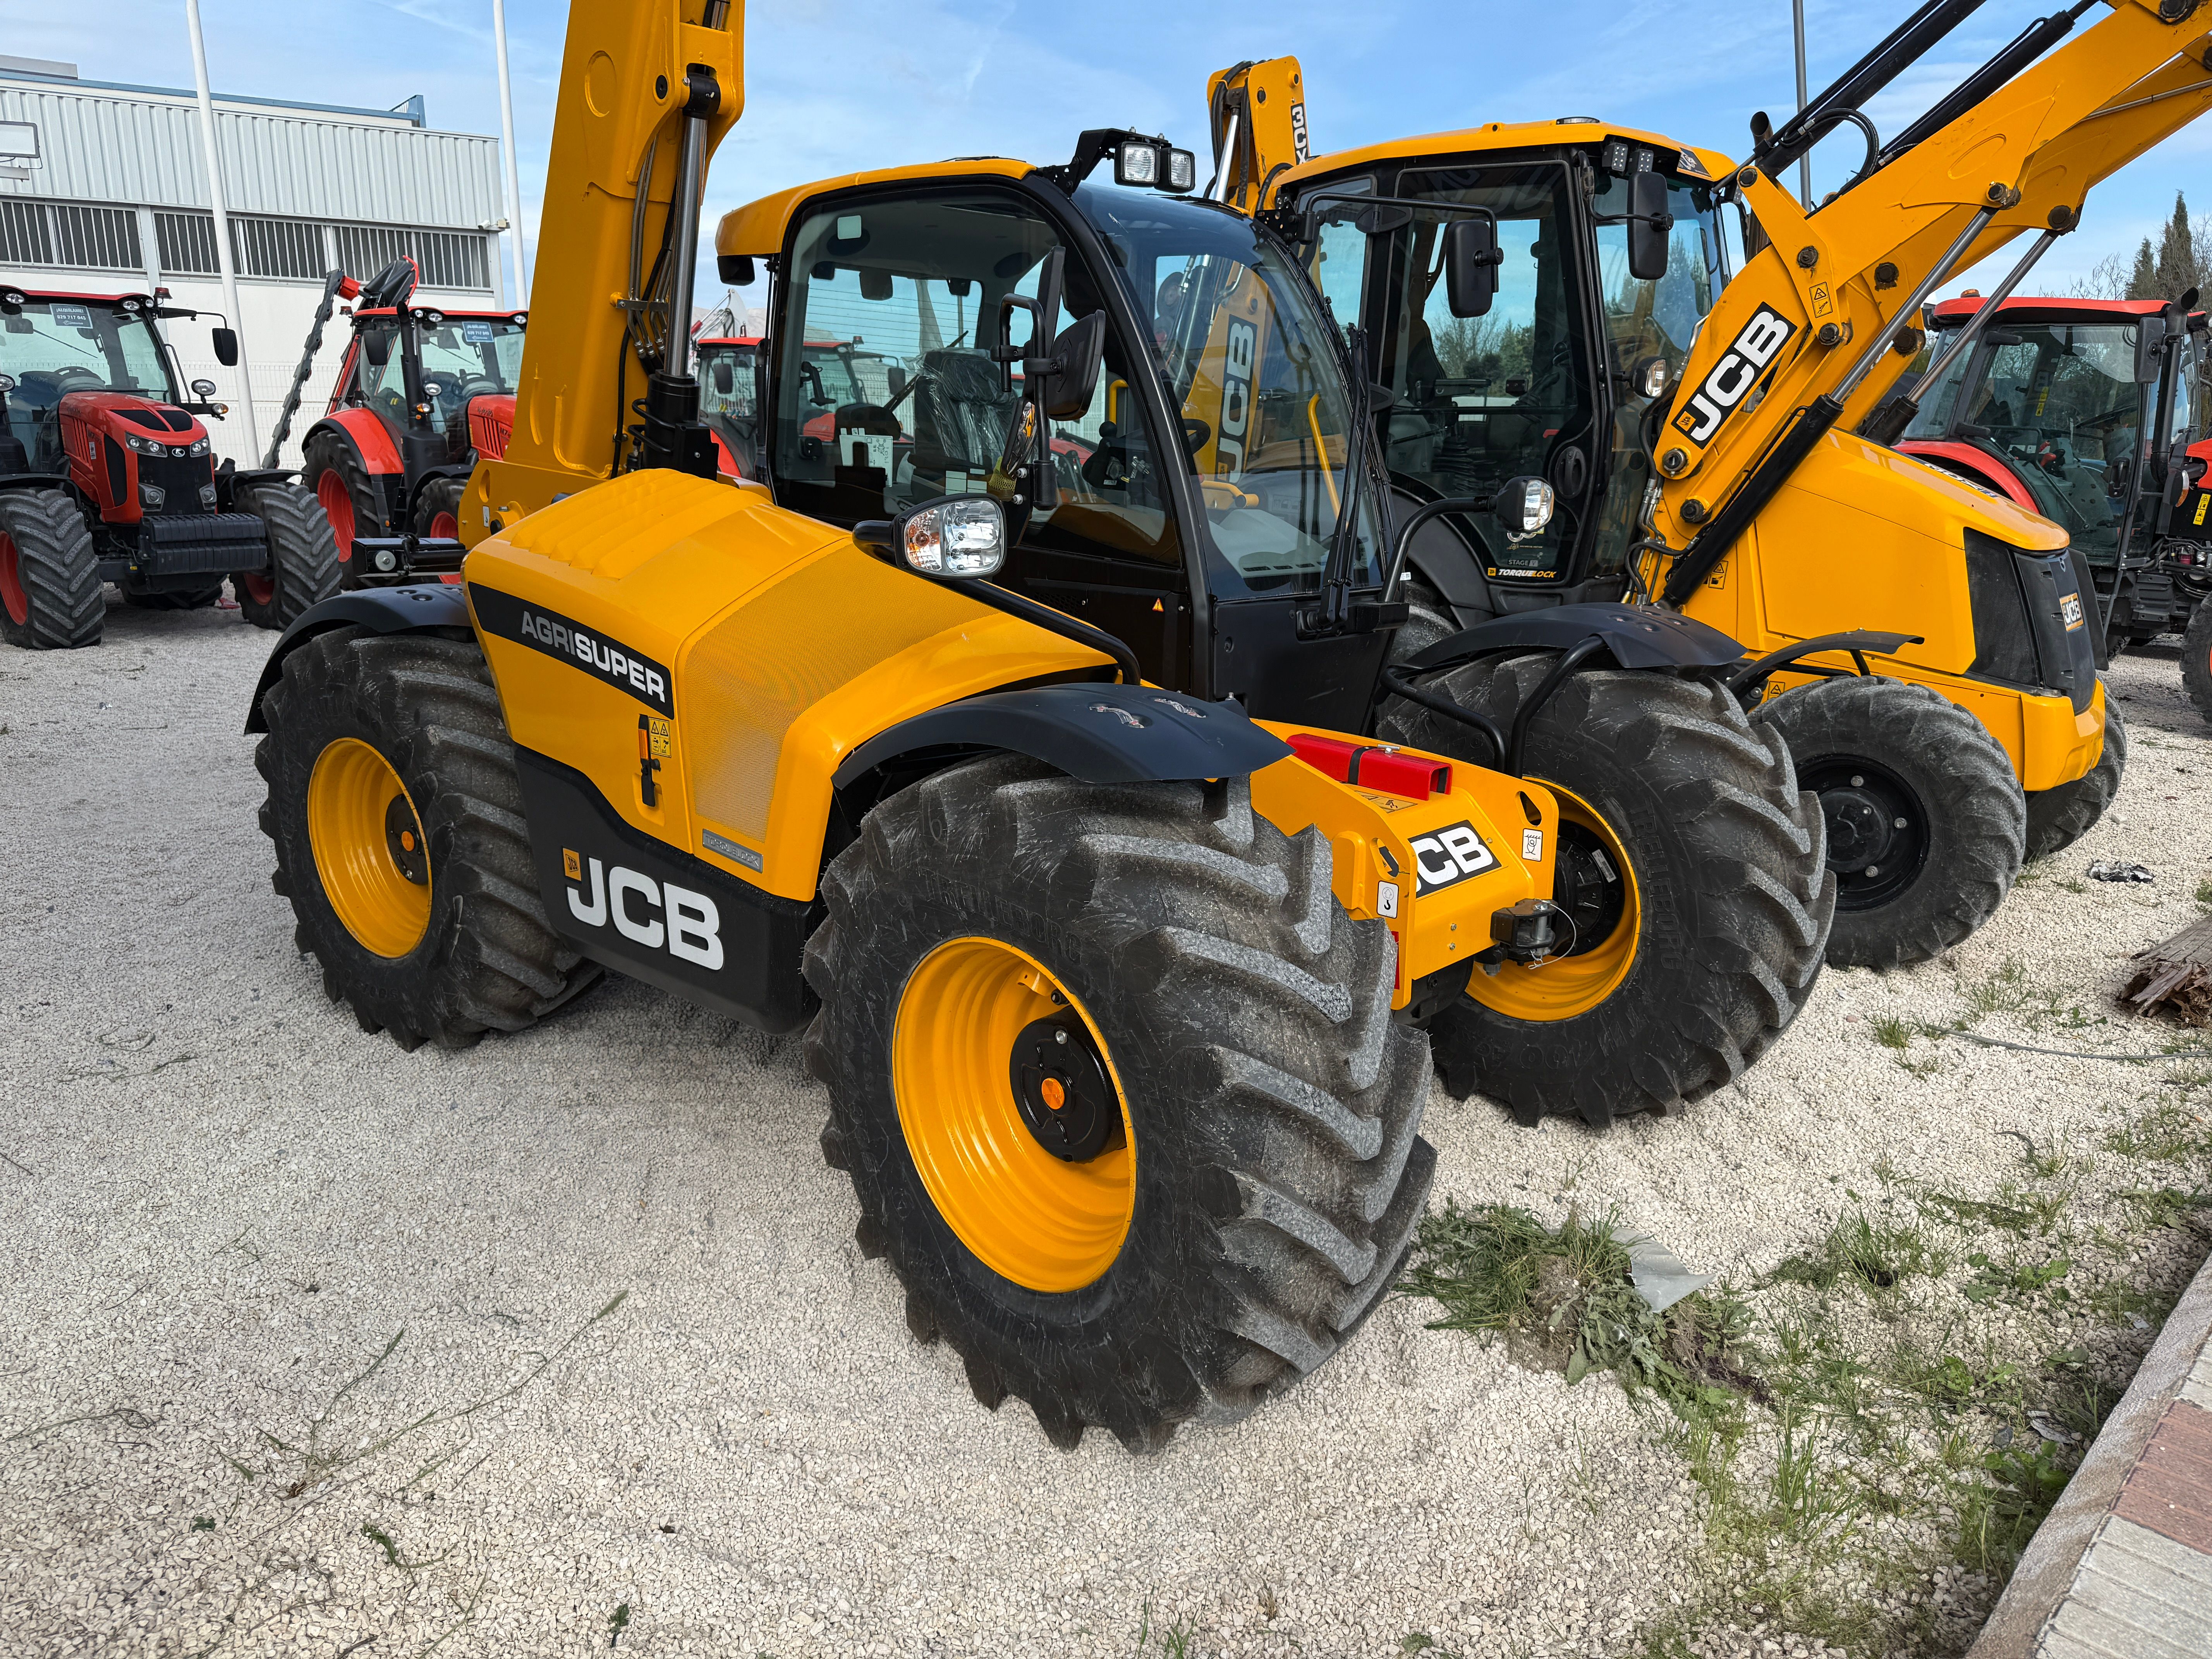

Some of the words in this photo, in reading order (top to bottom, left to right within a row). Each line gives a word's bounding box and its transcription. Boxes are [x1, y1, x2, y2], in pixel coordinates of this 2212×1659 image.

[1292, 106, 1307, 165] 3CX
[1219, 323, 1254, 483] JCB
[1690, 311, 1788, 441] JCB
[1498, 569, 1557, 578] TORQUELOCK
[2064, 600, 2081, 624] JCB
[521, 611, 665, 703] AGRISUPER
[706, 835, 759, 867] TORQUELOCK
[1411, 826, 1493, 892] CB
[567, 857, 724, 970] JCB
